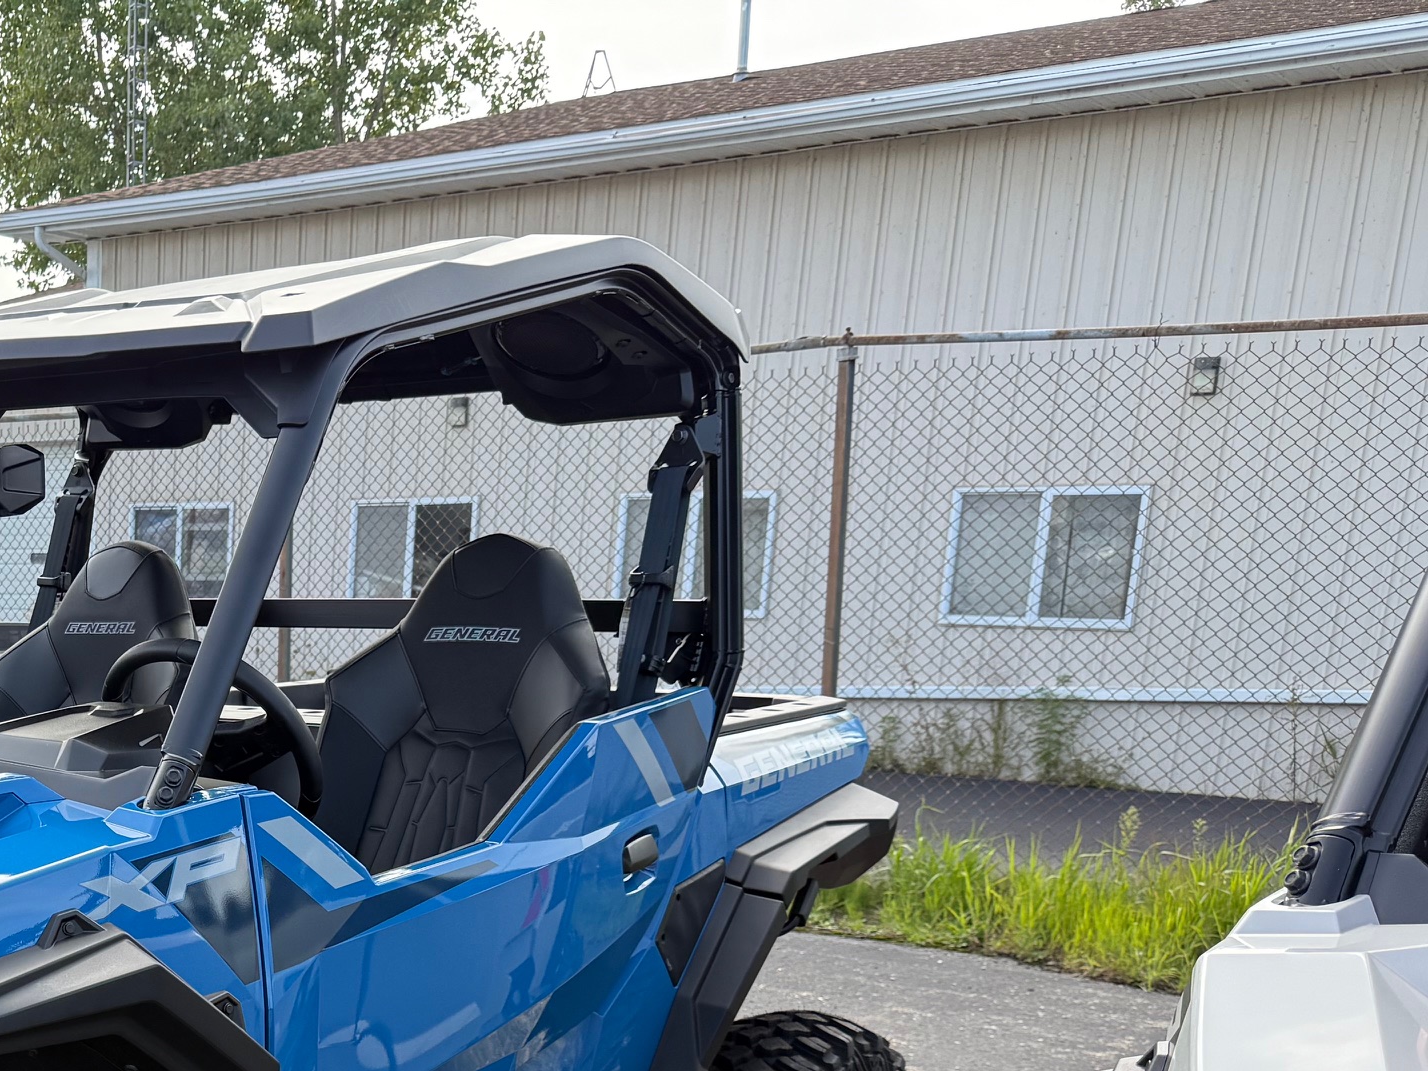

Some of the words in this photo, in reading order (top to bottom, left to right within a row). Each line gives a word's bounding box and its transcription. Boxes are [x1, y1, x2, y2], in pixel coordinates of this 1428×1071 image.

[64, 621, 136, 635] GENERAL
[423, 626, 521, 643] GENERAL
[79, 836, 242, 922] XP
